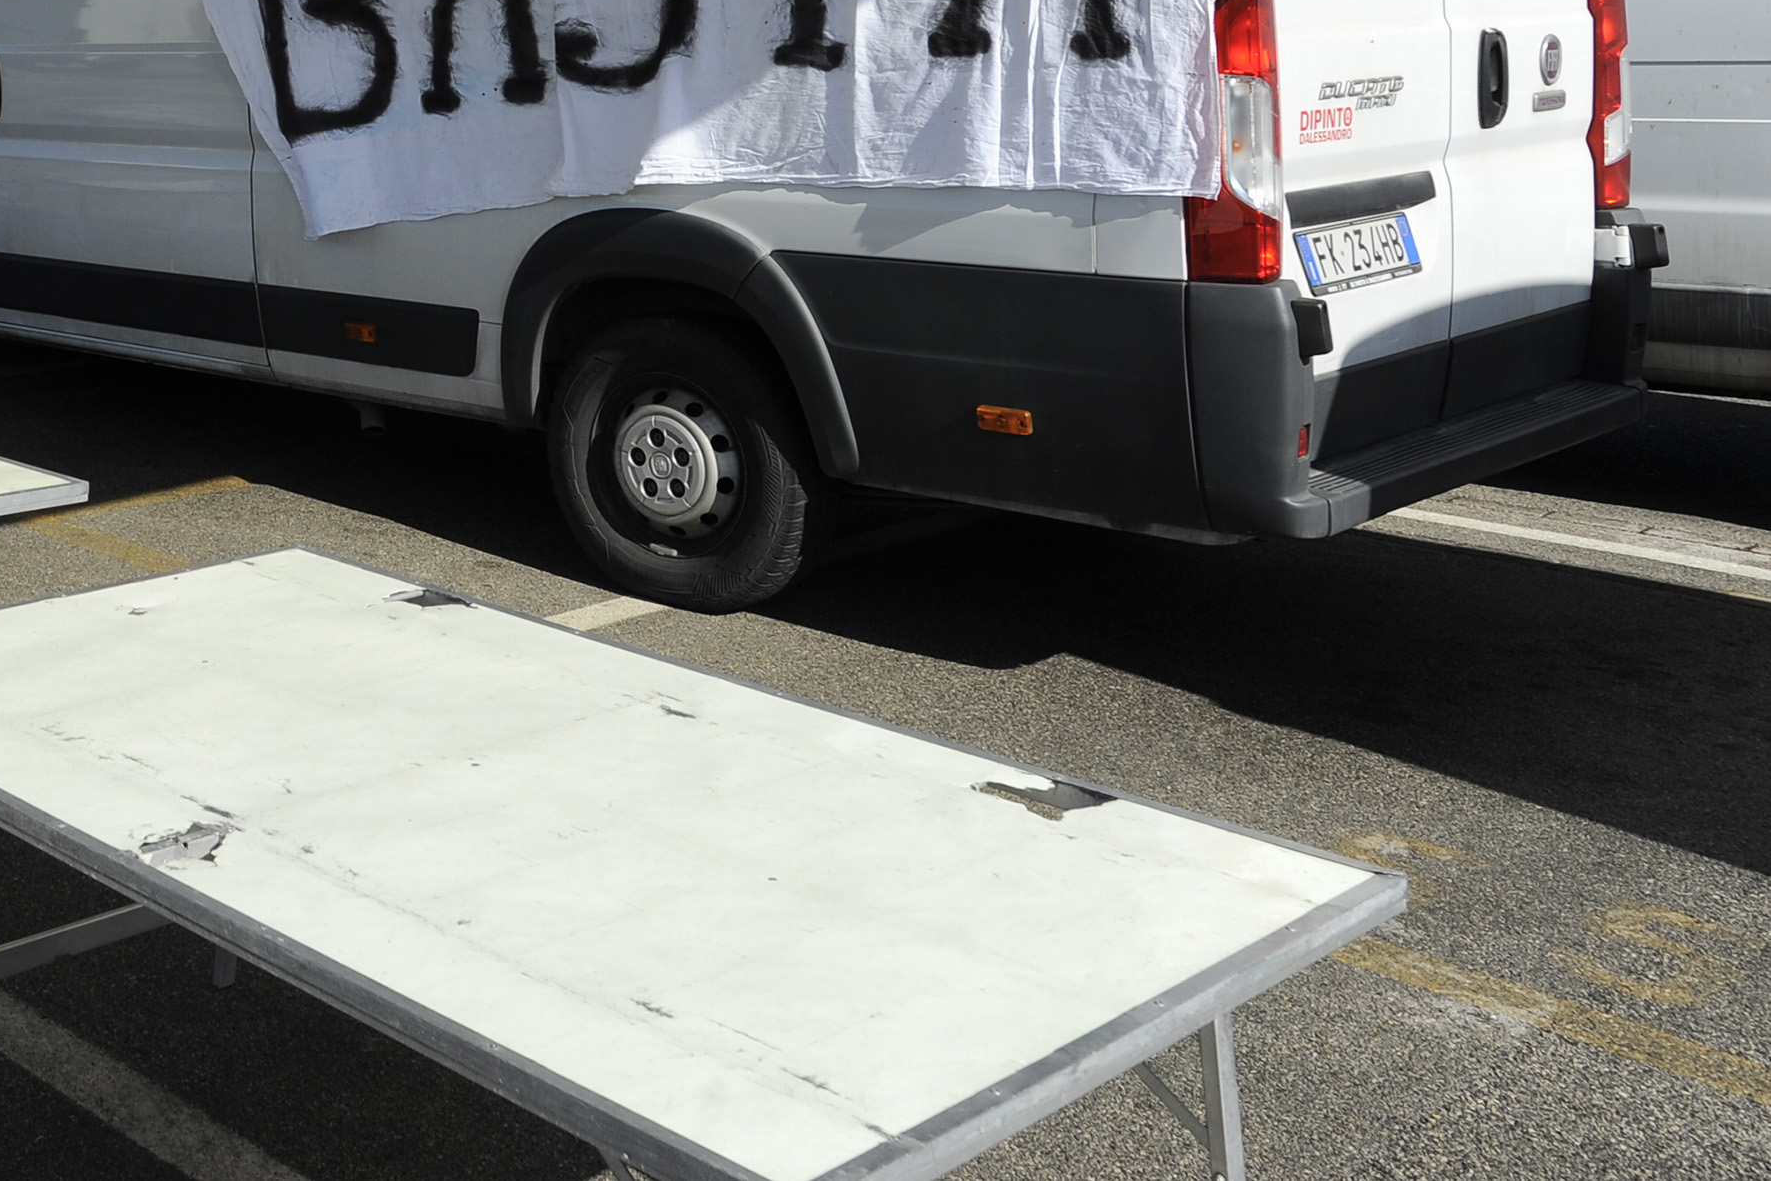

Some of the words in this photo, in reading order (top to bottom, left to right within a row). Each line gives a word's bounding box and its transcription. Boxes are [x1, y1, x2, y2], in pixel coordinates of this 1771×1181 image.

[1318, 75, 1404, 101] DUCATO
[1300, 106, 1353, 131] DIPINTO
[1312, 232, 1345, 279] FK
[1343, 223, 1405, 272] 234HB
